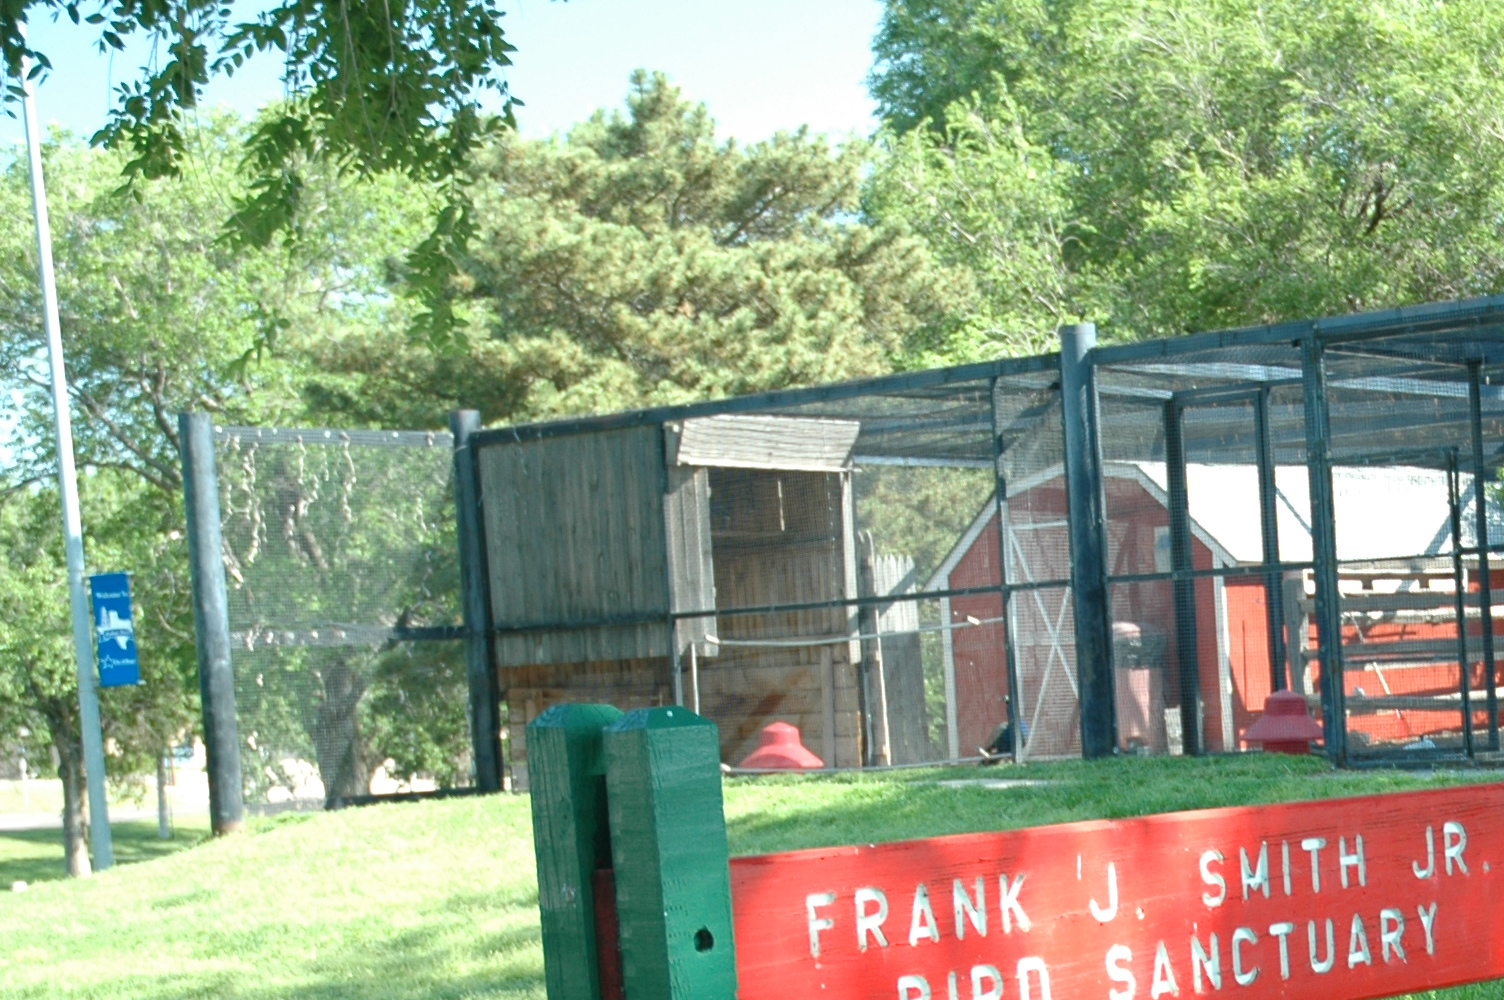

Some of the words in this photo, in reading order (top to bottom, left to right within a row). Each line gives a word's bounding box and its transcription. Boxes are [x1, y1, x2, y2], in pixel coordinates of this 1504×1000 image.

[805, 872, 1033, 959] FRANK
[1199, 833, 1367, 909] SMITH
[1411, 820, 1491, 880] JR.
